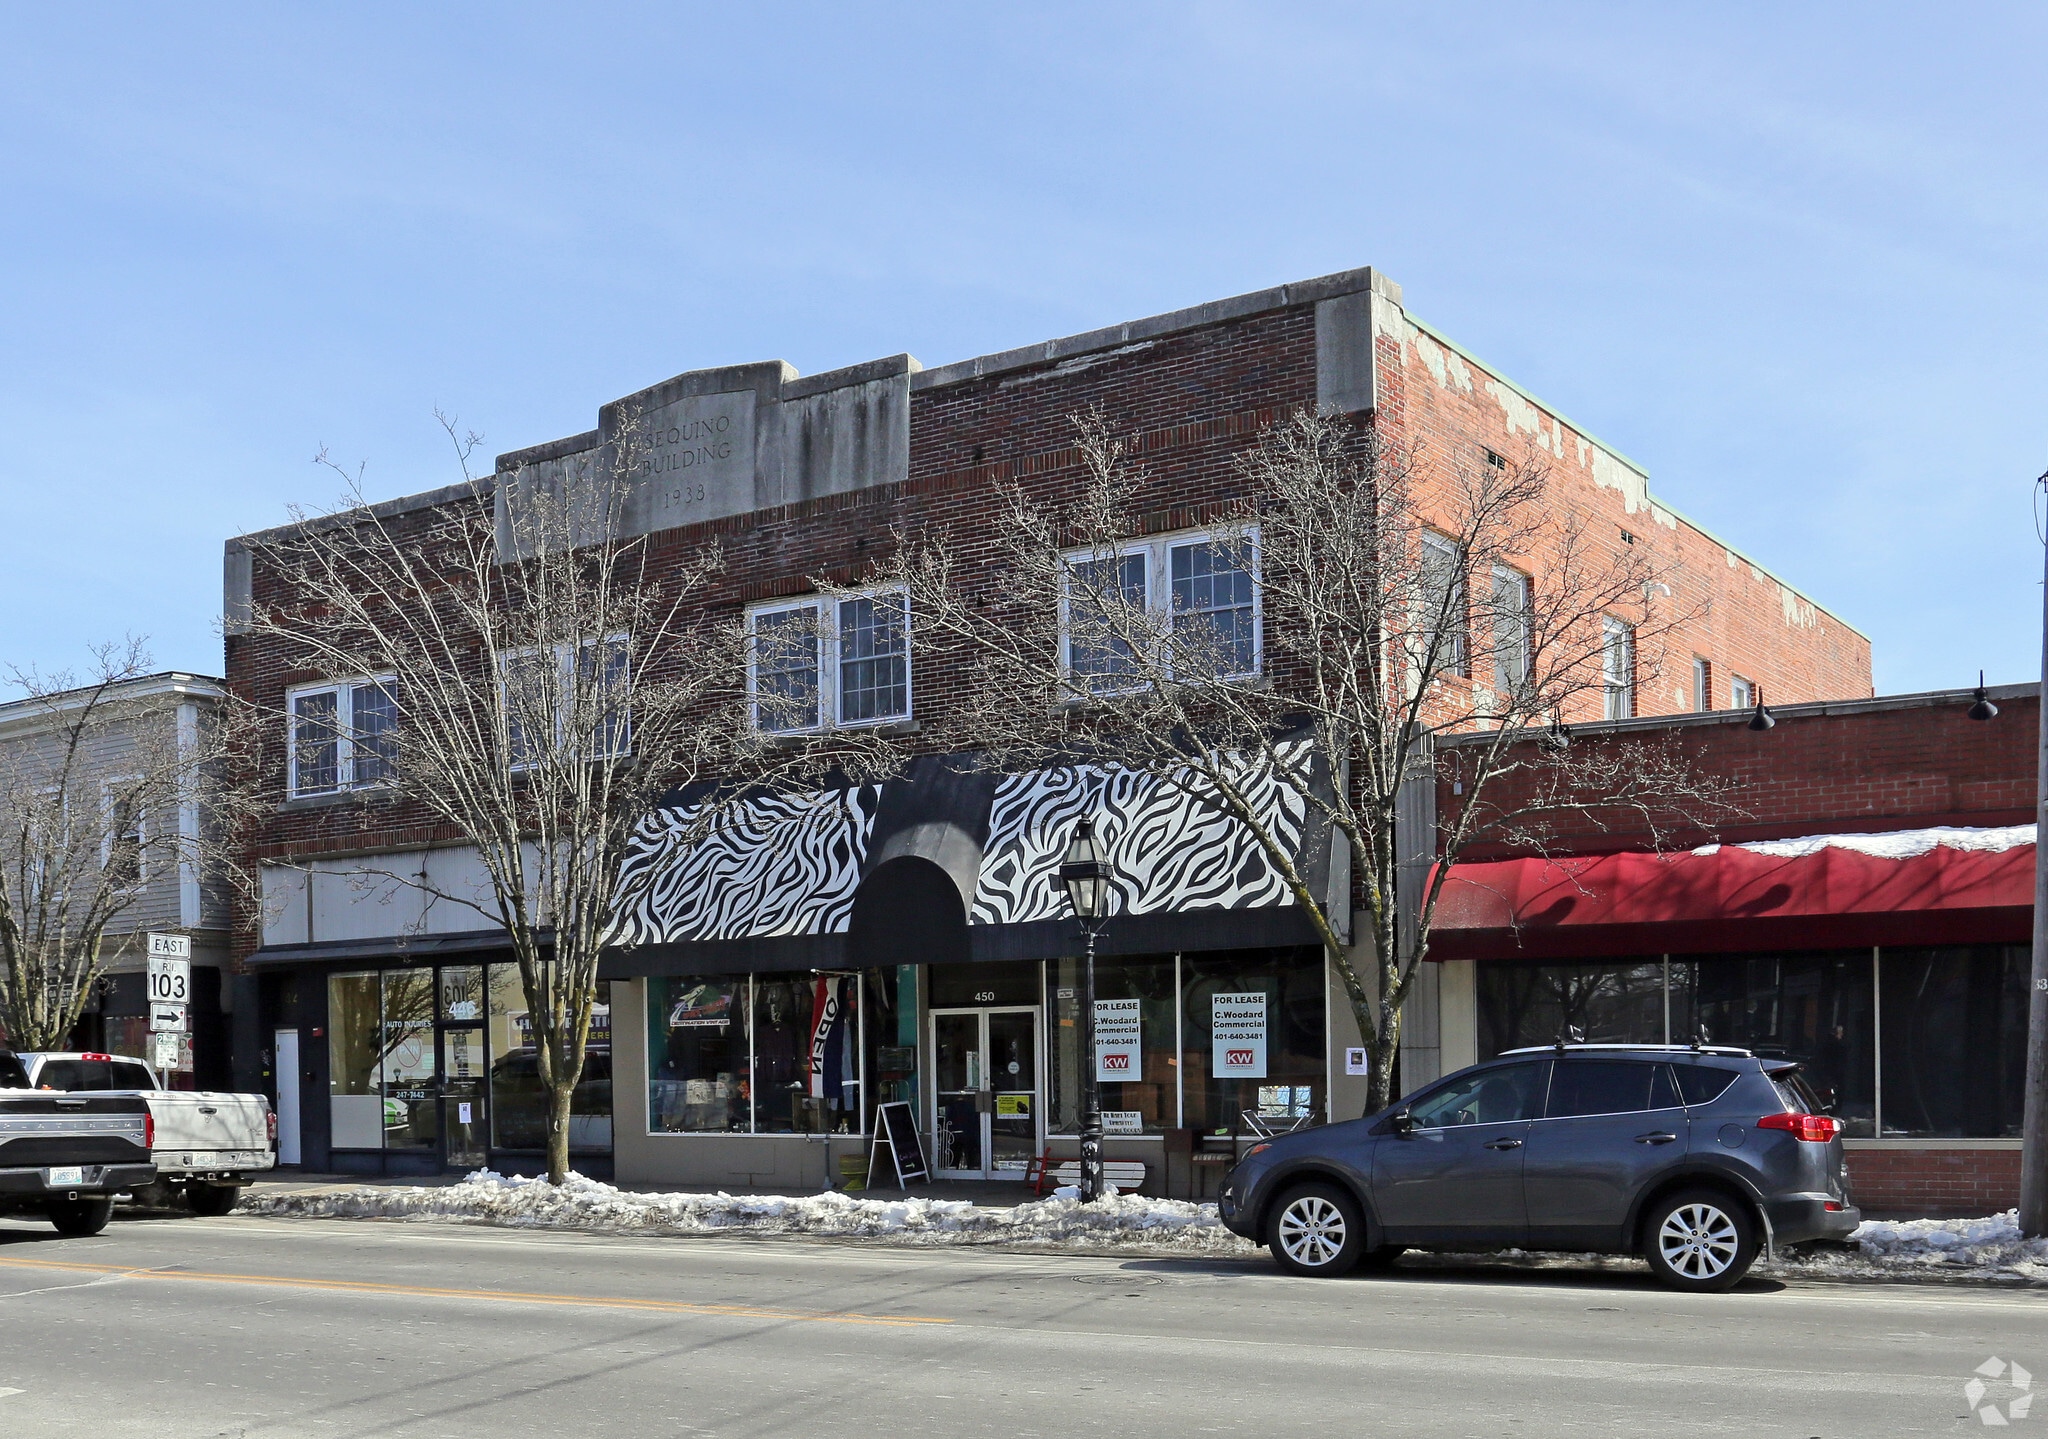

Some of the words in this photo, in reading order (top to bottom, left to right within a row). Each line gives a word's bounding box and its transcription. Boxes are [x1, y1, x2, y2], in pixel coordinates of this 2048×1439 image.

[644, 416, 730, 449] SEQUINO
[641, 442, 731, 477] BUILDING
[664, 484, 705, 508] 1938
[155, 939, 184, 953] EAST
[151, 973, 185, 998] 103
[975, 992, 995, 1001] 450
[1235, 996, 1264, 1004] LEASE
[449, 1001, 476, 1017] 446
[1215, 1011, 1263, 1019] C.Woodard
[812, 997, 838, 1075] OPEN
[1104, 1057, 1128, 1068] KW
[1227, 1053, 1253, 1064] KW
